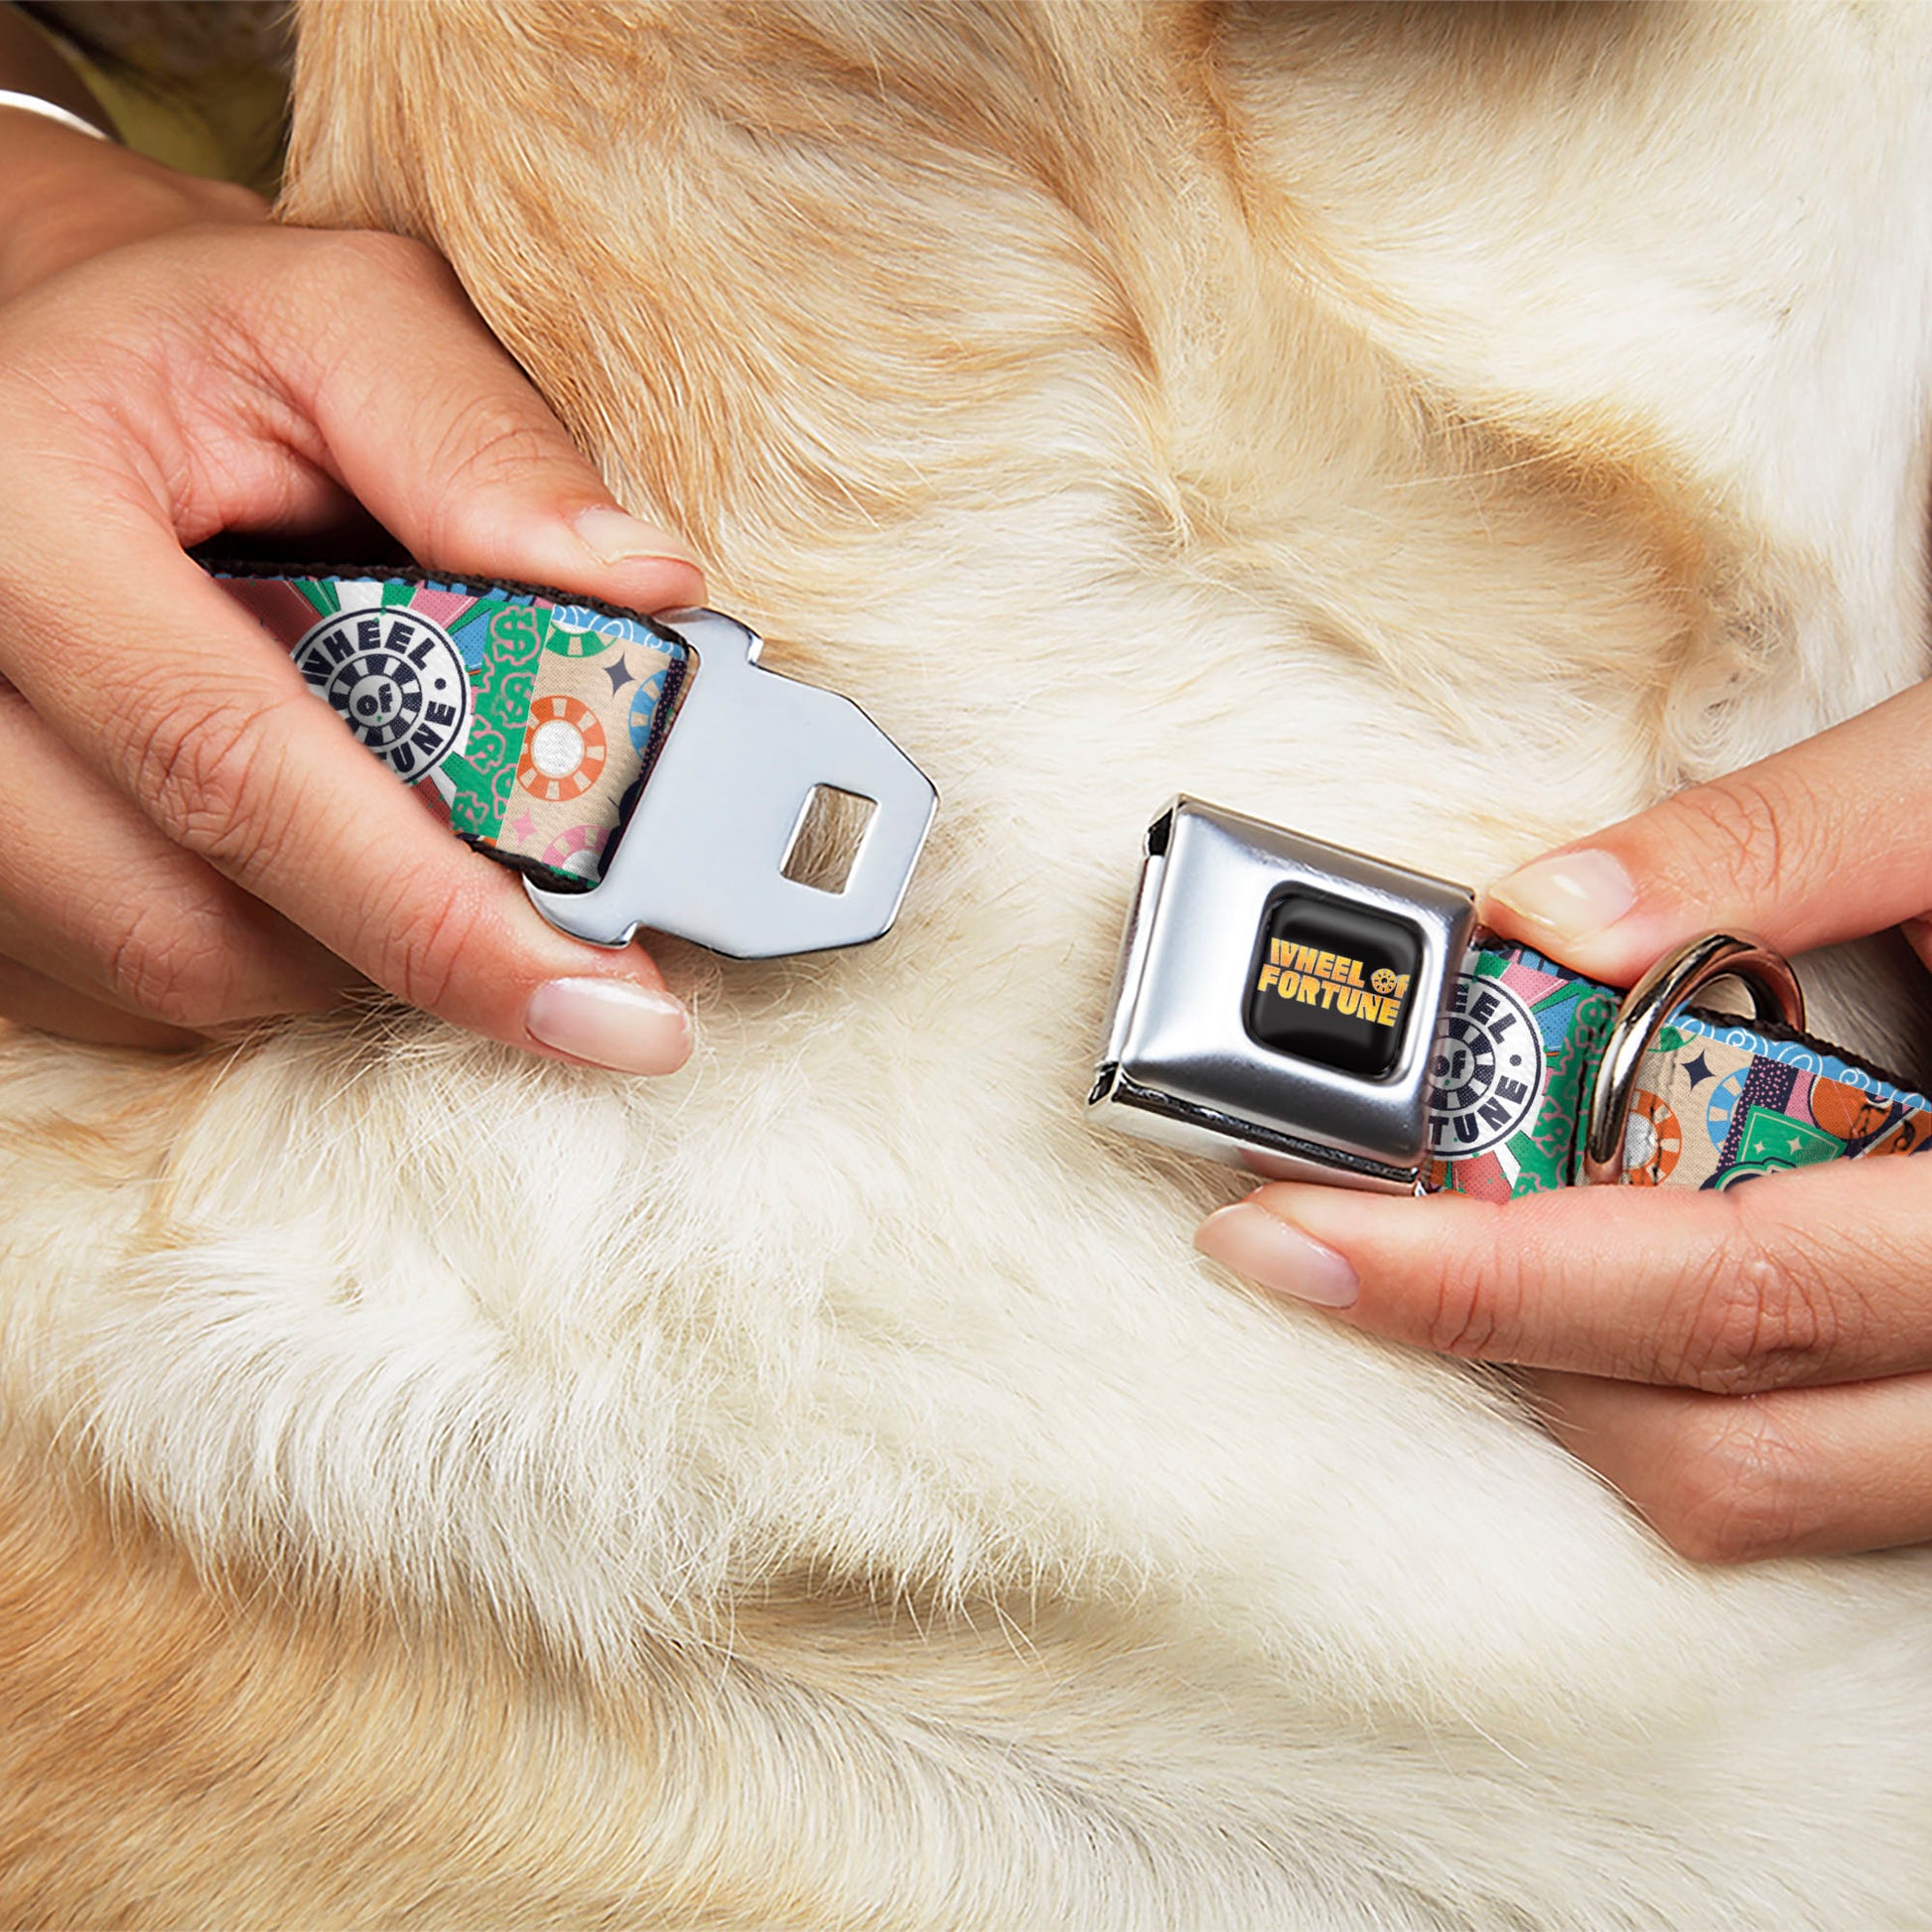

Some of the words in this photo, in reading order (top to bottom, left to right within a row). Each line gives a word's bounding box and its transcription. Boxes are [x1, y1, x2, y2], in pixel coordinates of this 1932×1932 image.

[301, 620, 435, 686] WHEEL
[1270, 937, 1365, 988] WHEEL
[1257, 963, 1401, 1028] FORTUNE
[1446, 983, 1517, 1044] EEL
[1429, 1074, 1529, 1146] TUNE
